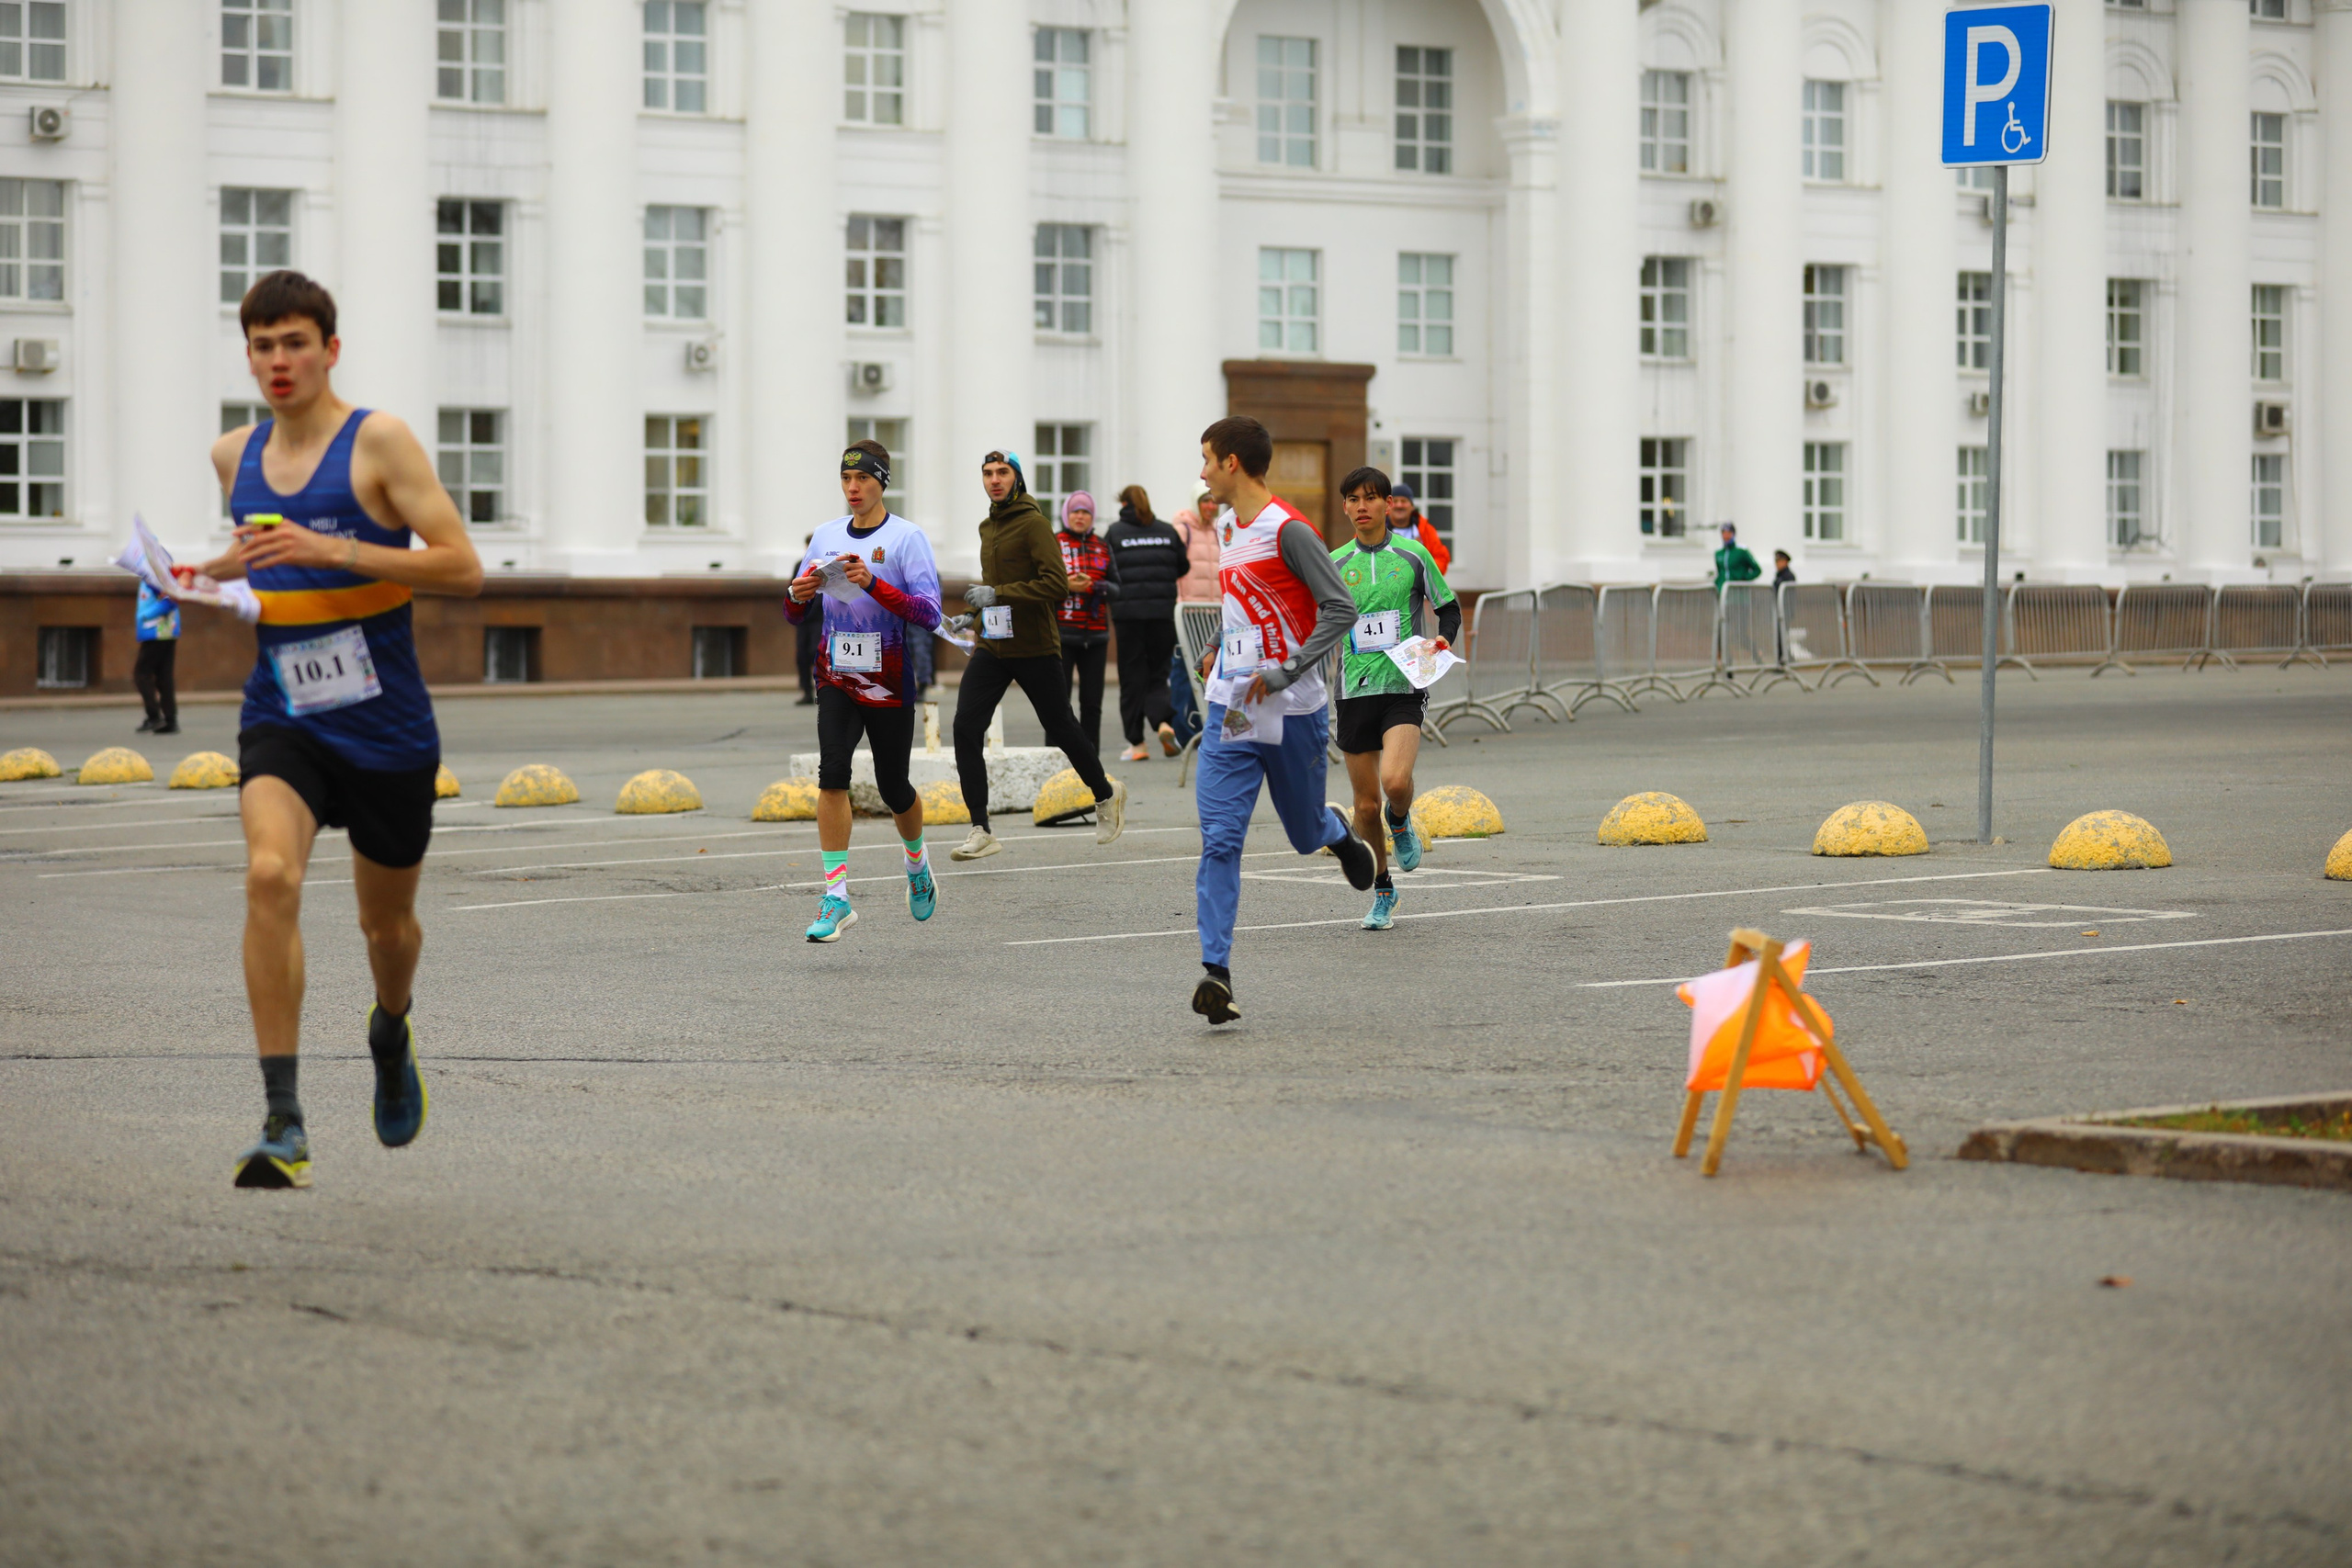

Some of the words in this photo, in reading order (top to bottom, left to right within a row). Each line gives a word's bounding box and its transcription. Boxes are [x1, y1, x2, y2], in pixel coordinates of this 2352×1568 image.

[1963, 25, 2021, 146] P
[988, 615, 998, 626] 6.1
[1231, 571, 1247, 595] Run
[1248, 595, 1272, 619] and
[1264, 622, 1282, 655] think
[1363, 621, 1384, 636] 4.1
[842, 642, 863, 656] 9.1
[293, 654, 345, 685] 10.1
